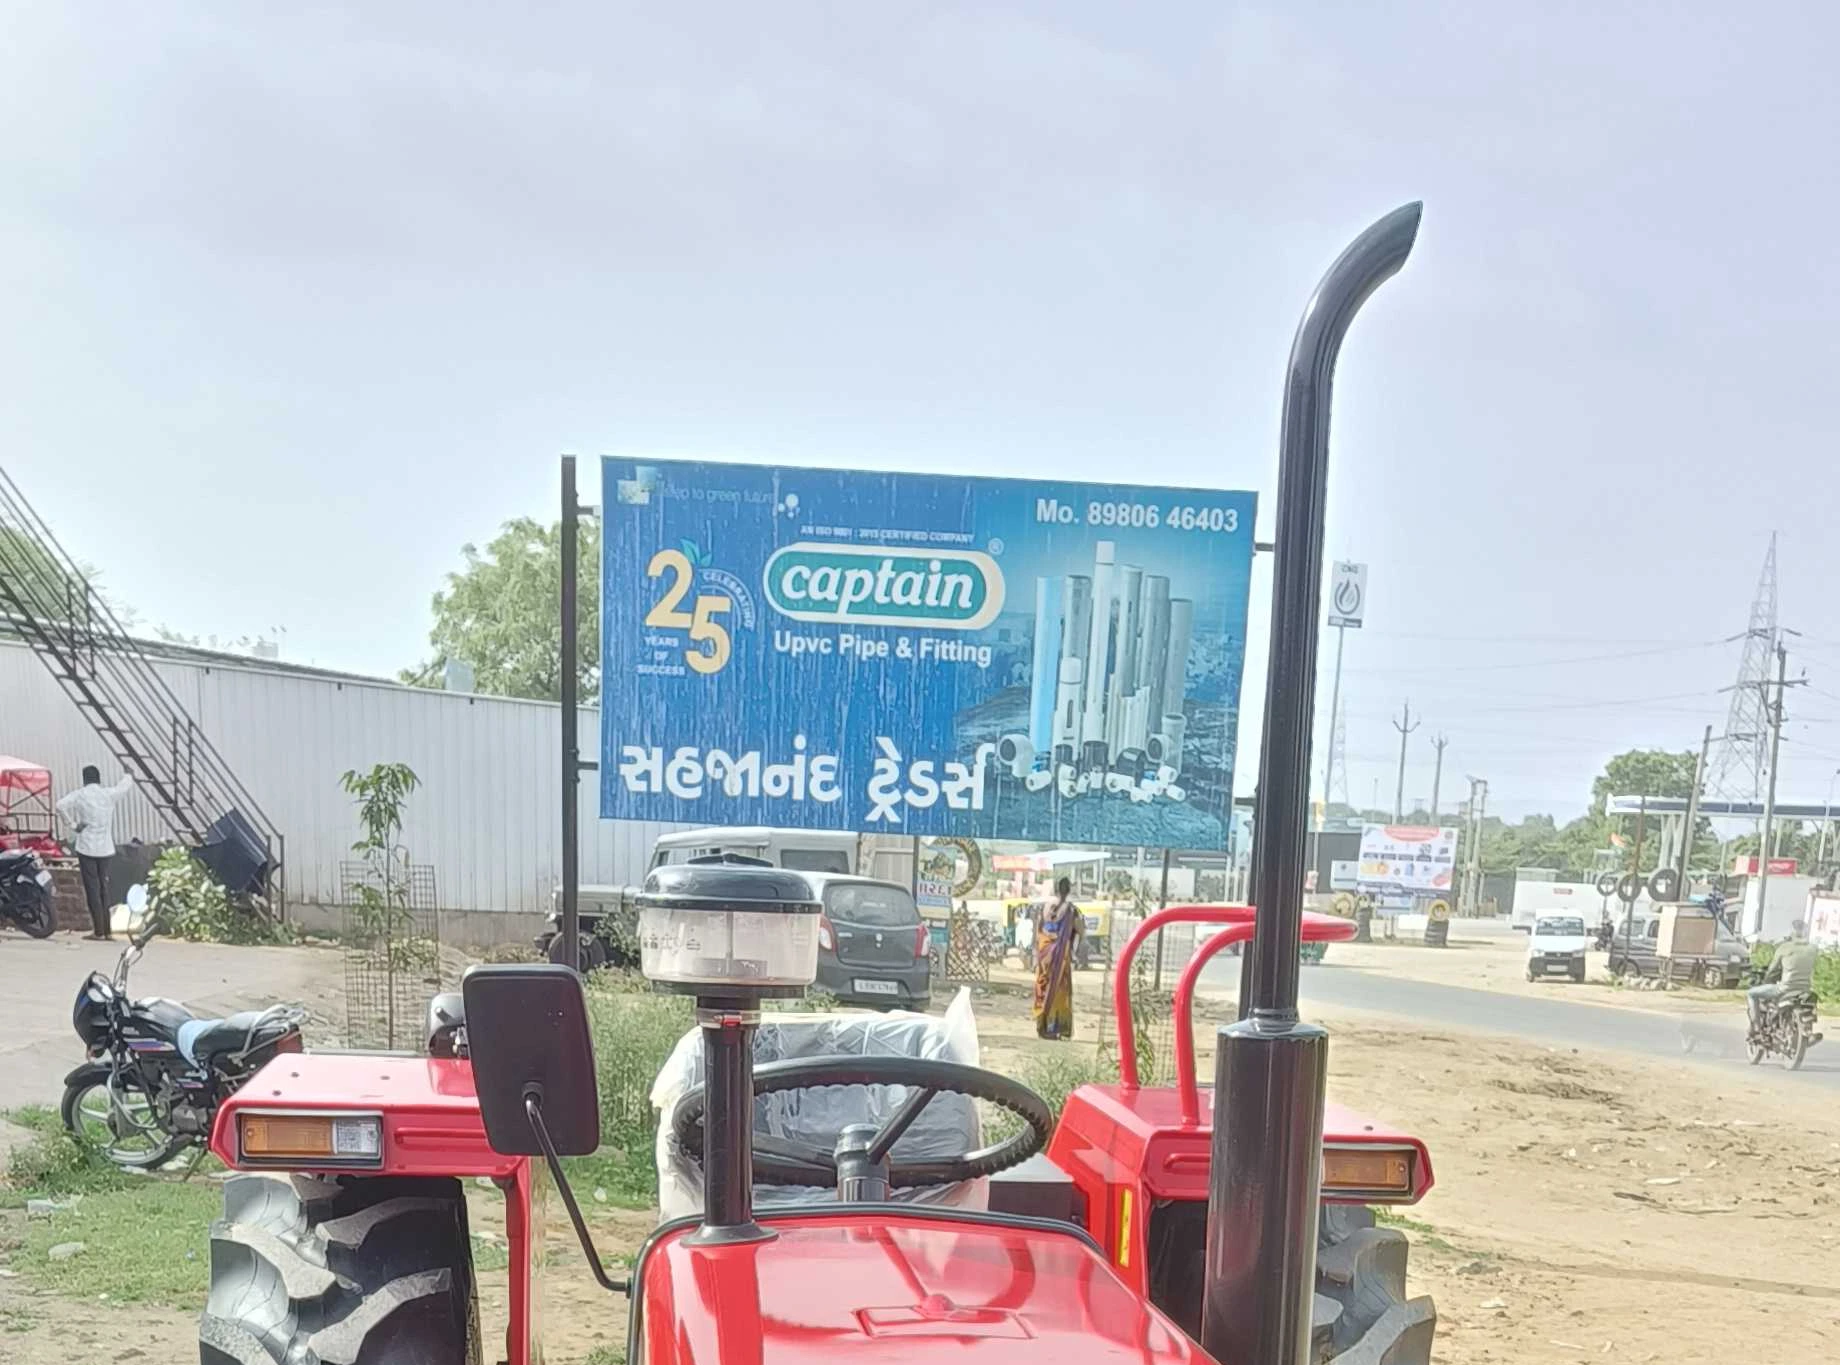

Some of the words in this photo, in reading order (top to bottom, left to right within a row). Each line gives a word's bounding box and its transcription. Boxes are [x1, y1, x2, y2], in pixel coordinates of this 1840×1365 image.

[929, 531, 976, 544] COMPANY
[1036, 498, 1080, 524] Mo.
[1087, 501, 1160, 528] 89806
[1166, 506, 1239, 532] 46403
[781, 559, 974, 615] captain
[645, 548, 732, 675] 25
[774, 630, 832, 658] Upvc
[838, 633, 889, 661] Pipe
[895, 636, 913, 659] &
[919, 637, 993, 669] Fitting
[618, 734, 842, 803] સહજાનંદ
